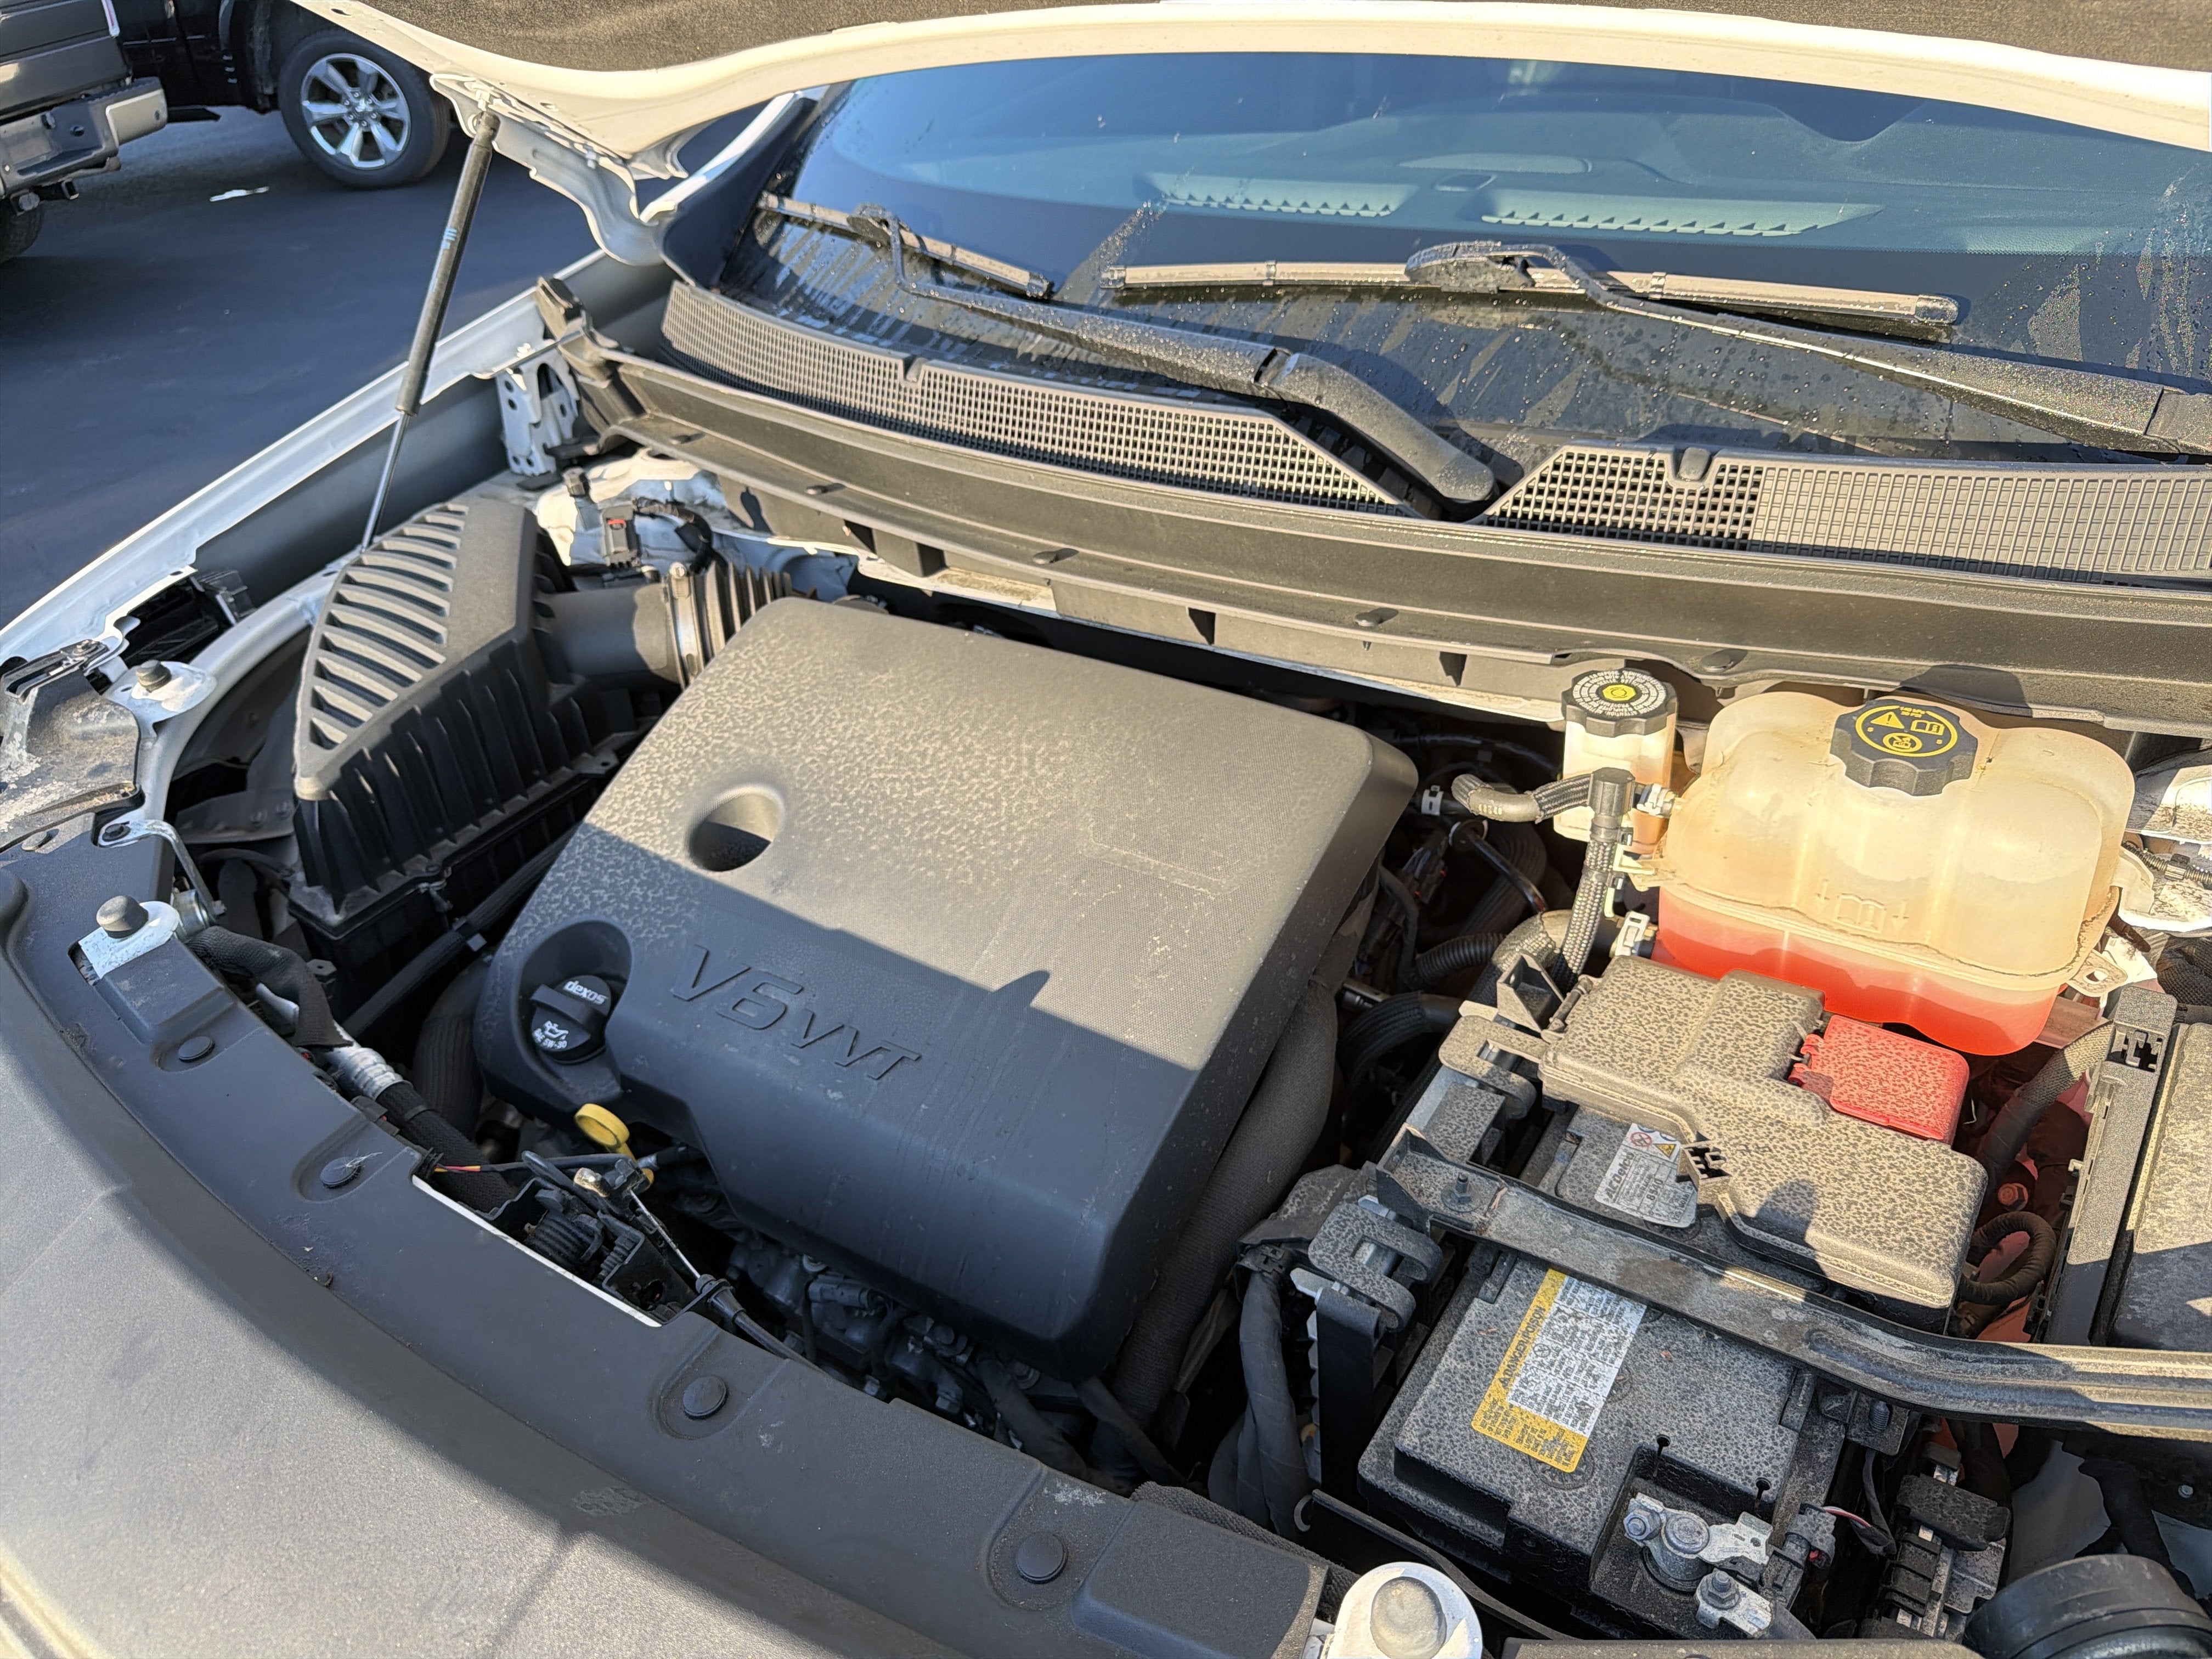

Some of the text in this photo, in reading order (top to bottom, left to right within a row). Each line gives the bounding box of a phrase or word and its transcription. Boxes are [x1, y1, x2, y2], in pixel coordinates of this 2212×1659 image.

[563, 980, 608, 1005] dexos
[541, 1038, 567, 1049] 5W-30
[1605, 1152, 1635, 1199] ACDelco
